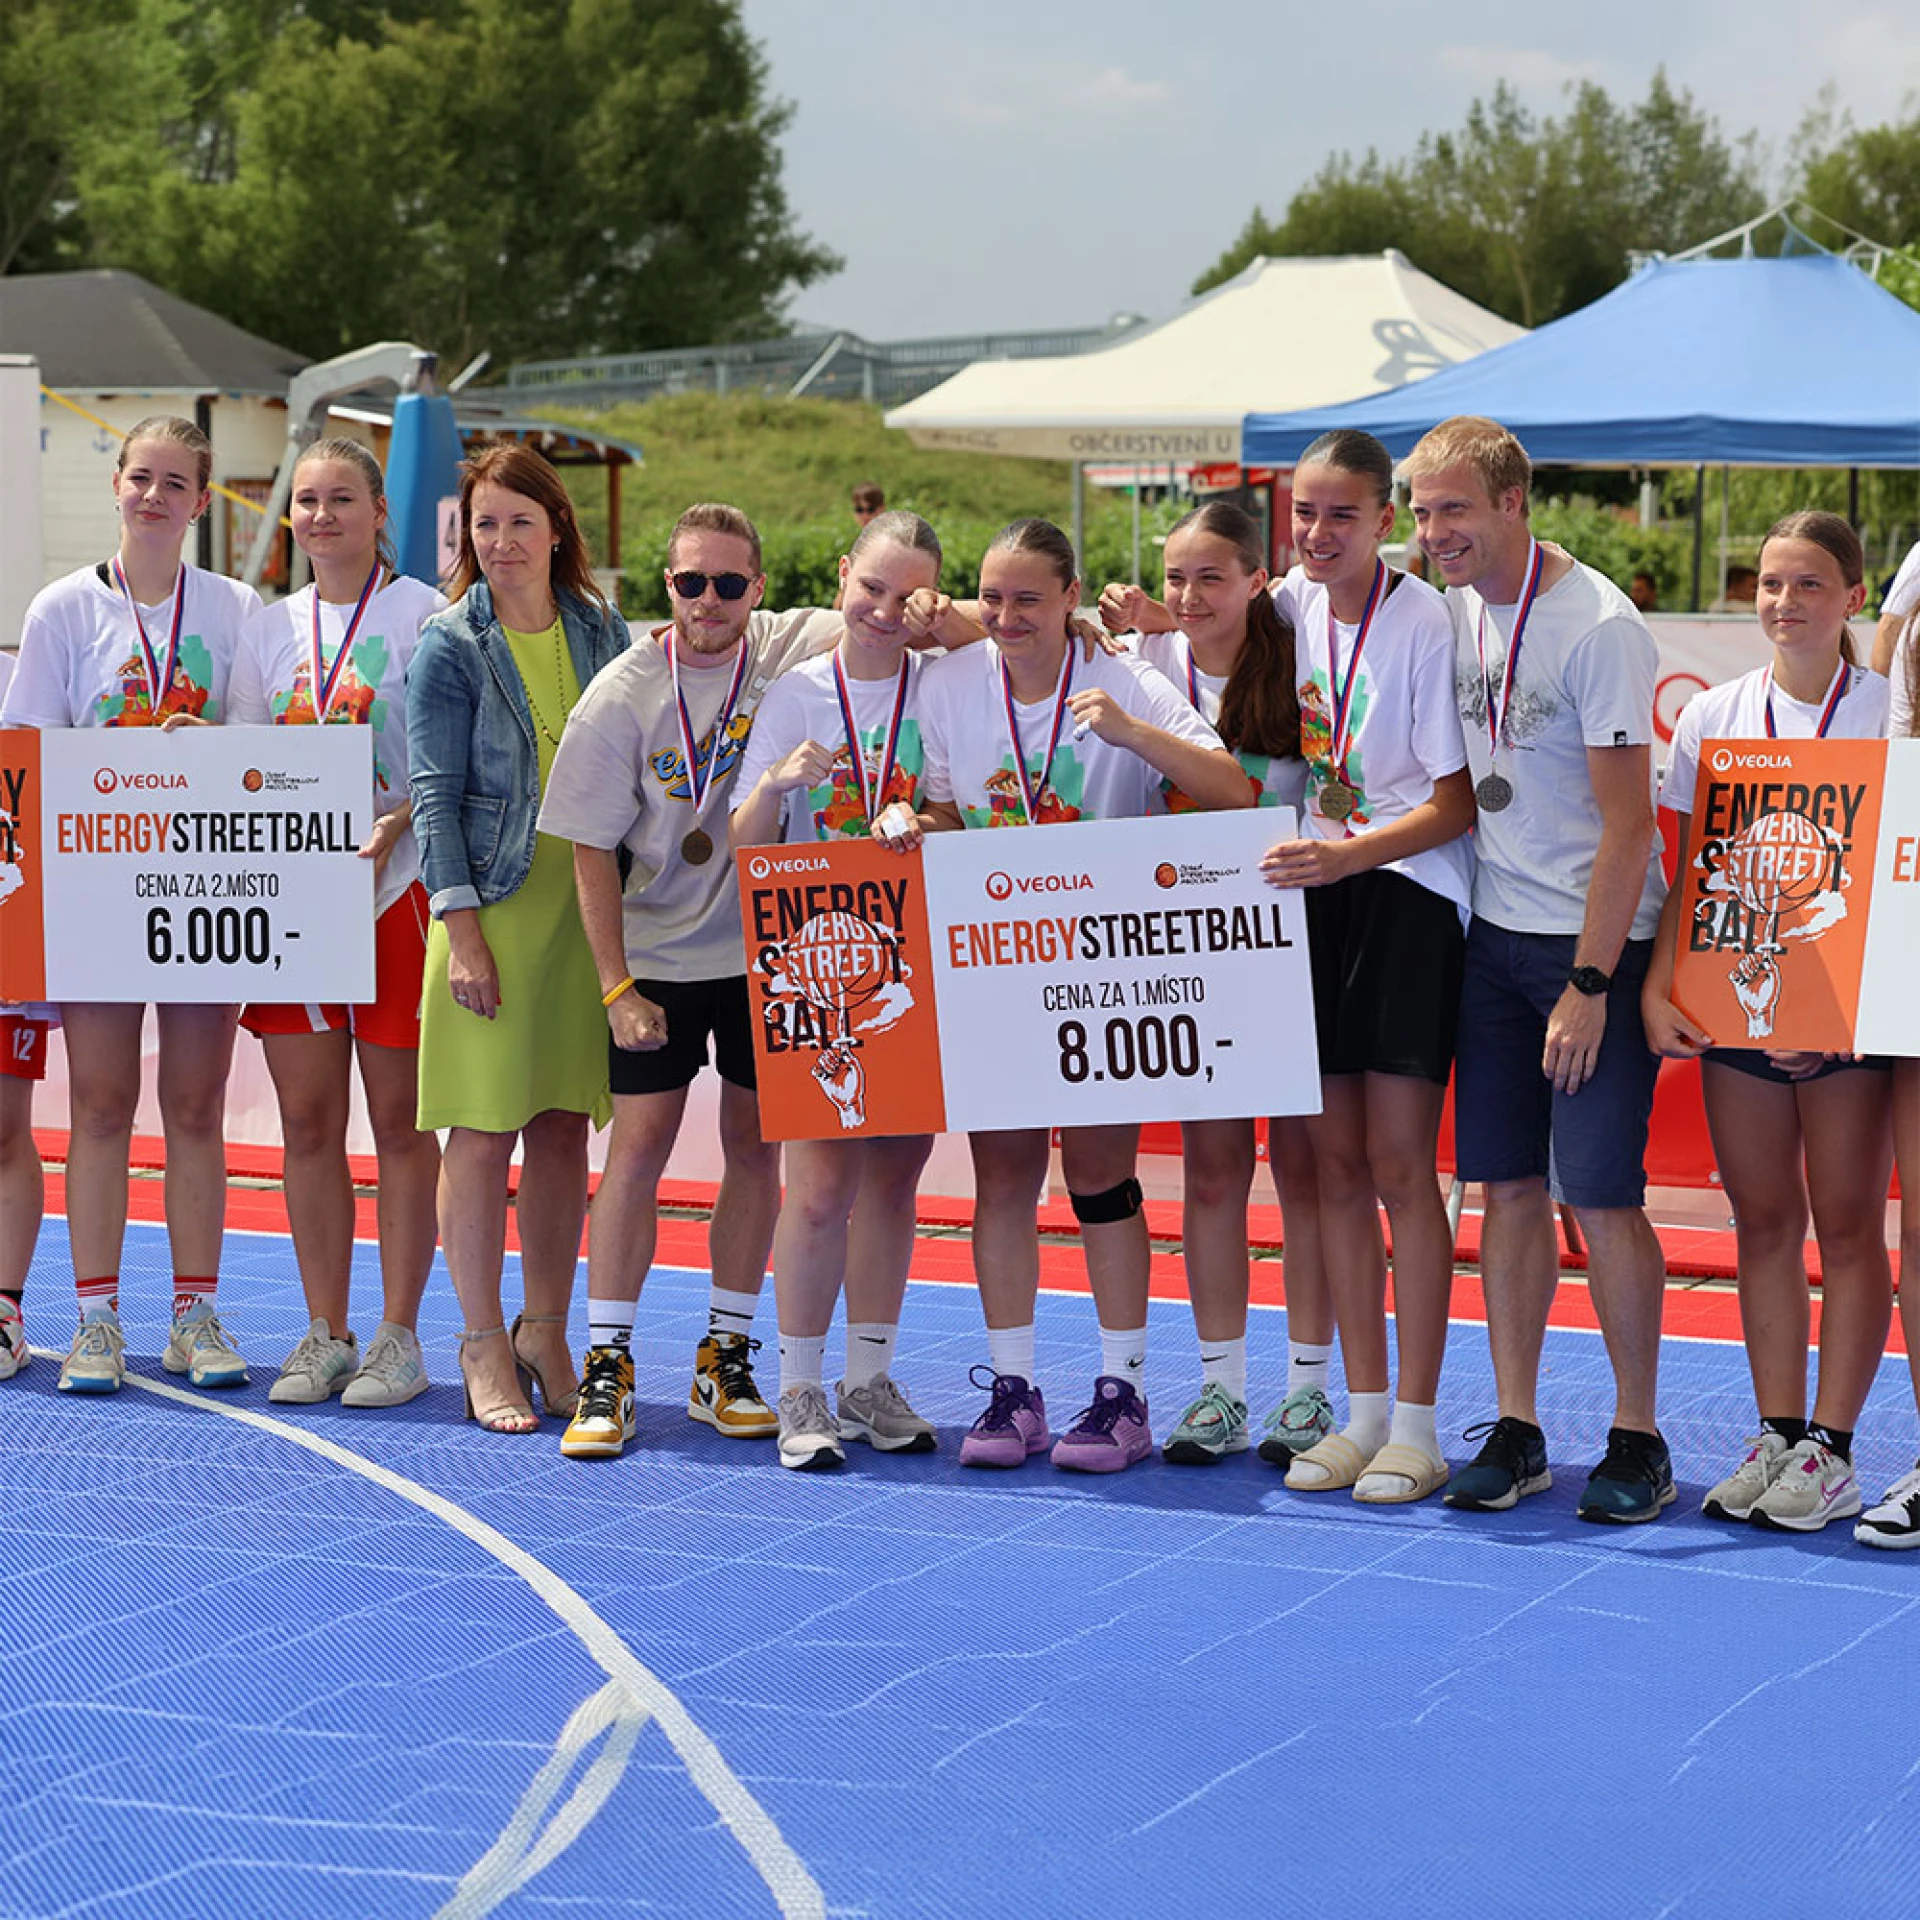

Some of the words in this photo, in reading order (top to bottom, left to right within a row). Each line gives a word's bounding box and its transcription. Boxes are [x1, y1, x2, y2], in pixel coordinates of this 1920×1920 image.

[1069, 430, 1209, 454] OBČERSTVENÍ
[1216, 433, 1233, 453] U
[1736, 754, 1792, 768] VEOLIA
[121, 773, 189, 789] VEOLIA
[1704, 782, 1867, 837] ENERGY
[57, 811, 360, 853] ENERGYSTREETBALL
[135, 873, 179, 898] CENA
[184, 873, 207, 898] ZA
[210, 869, 279, 898] 2.MÍSTO
[772, 857, 830, 874] VEOLIA
[1016, 873, 1094, 893] VEOLIA
[752, 878, 907, 942] ENERGY
[146, 906, 301, 971] 6.000,-
[948, 903, 1293, 968] ENERGYSTREETBALL
[1043, 983, 1095, 1011] CENA
[1099, 981, 1126, 1008] ZA
[1131, 973, 1205, 1006] 1.MÍSTO
[13, 1027, 36, 1061] 12
[1057, 1013, 1233, 1083] 8.000,-
